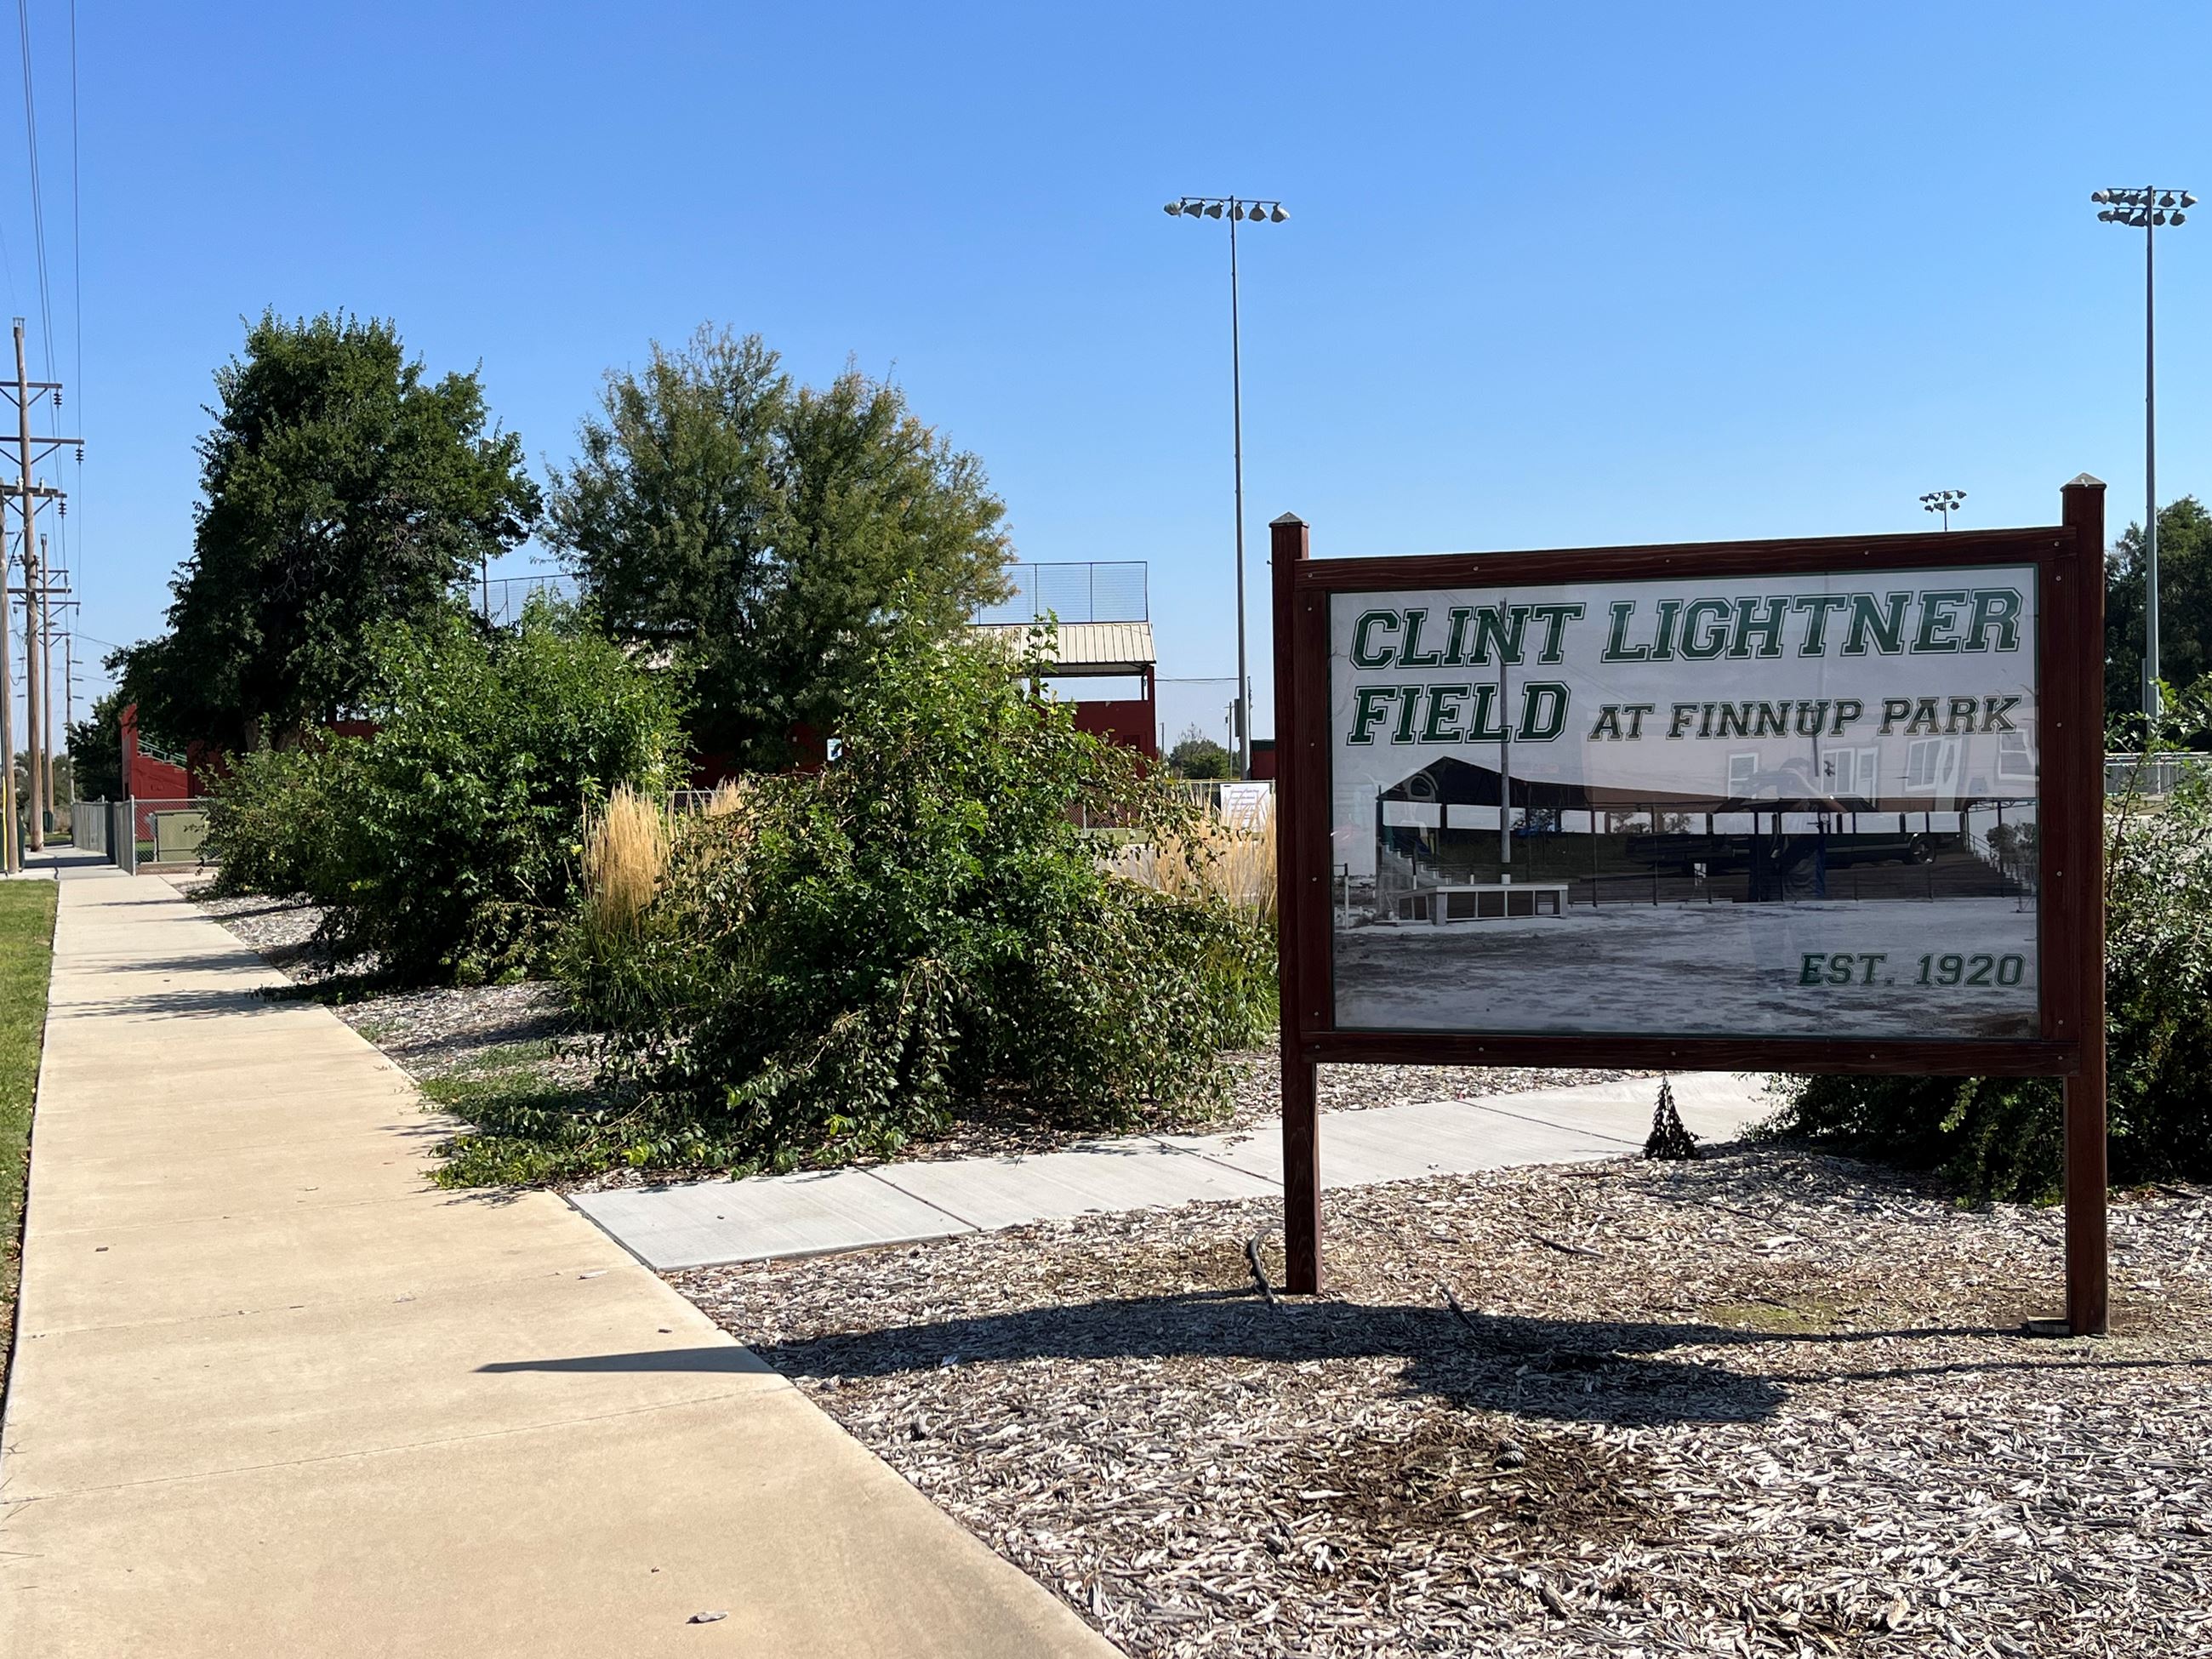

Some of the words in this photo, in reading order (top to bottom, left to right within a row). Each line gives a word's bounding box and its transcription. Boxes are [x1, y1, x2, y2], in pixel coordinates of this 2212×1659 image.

[1349, 601, 1587, 670] CLINT
[1600, 587, 2022, 663] LIGHTNER
[1347, 681, 1572, 746] FIELD
[1588, 703, 1655, 742] AT
[1665, 697, 1863, 740] FINNUP
[1878, 694, 2022, 736] PARK
[1799, 952, 1894, 987] EST.
[1914, 952, 2026, 988] 1920
